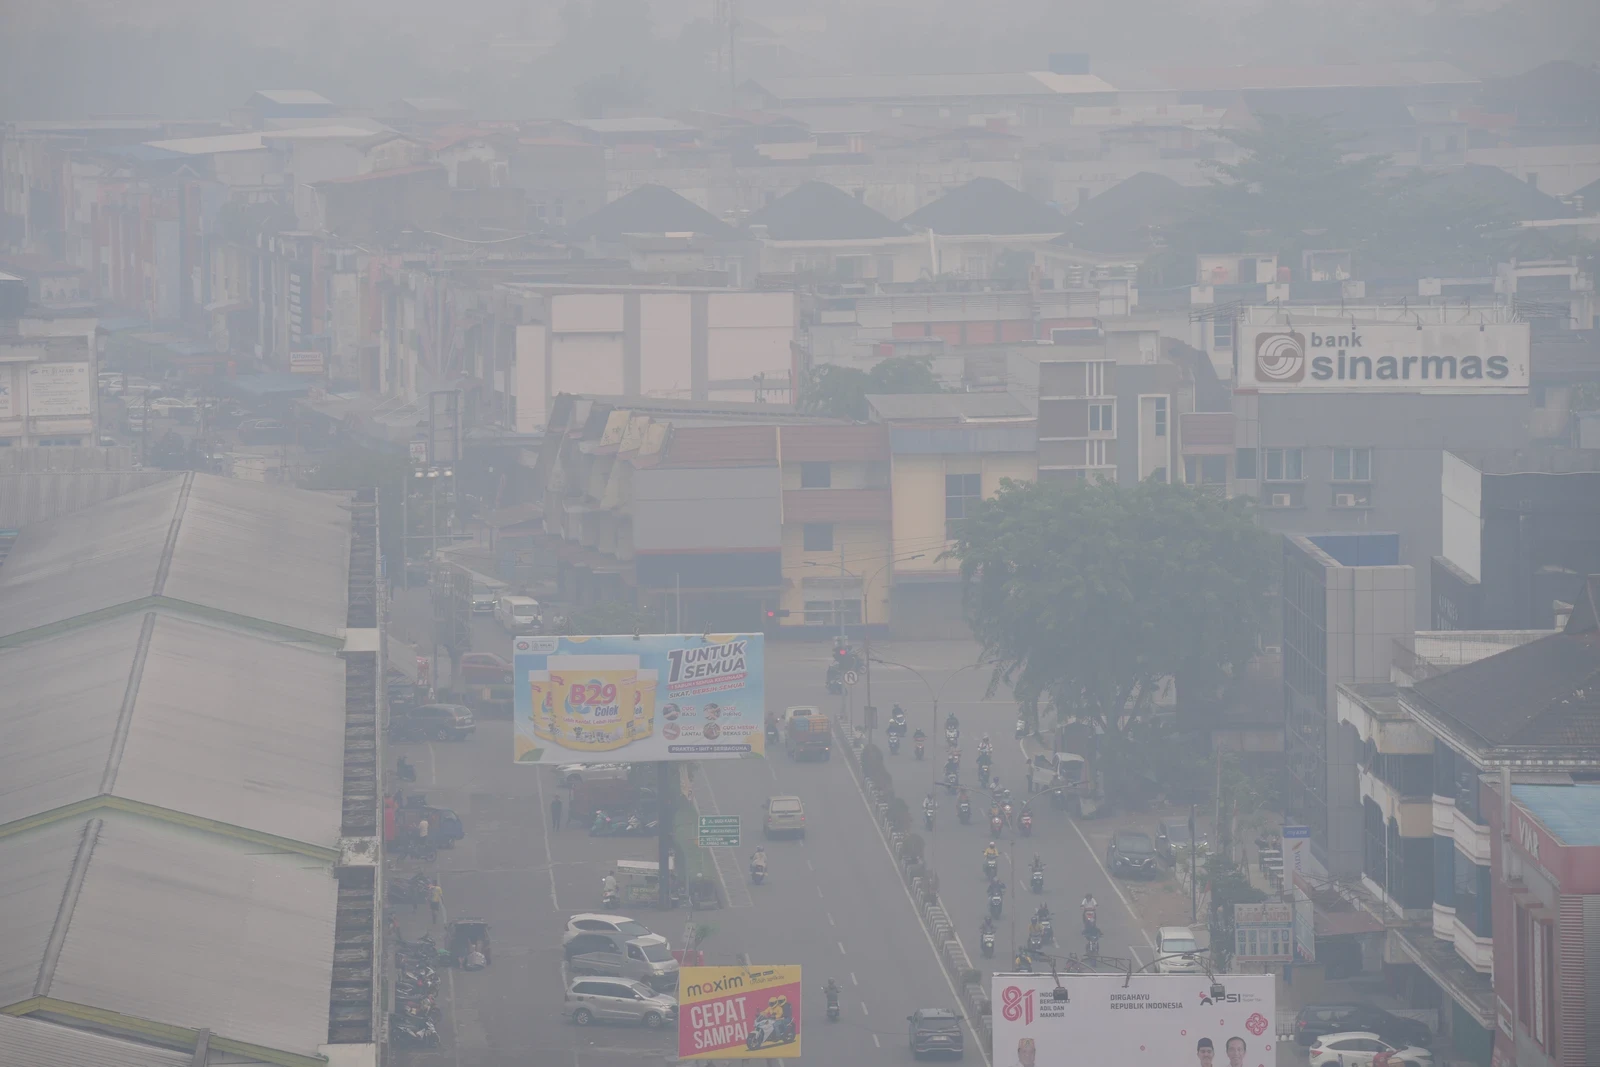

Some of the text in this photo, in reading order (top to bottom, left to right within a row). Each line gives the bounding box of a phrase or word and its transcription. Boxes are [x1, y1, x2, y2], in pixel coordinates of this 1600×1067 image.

[1311, 332, 1362, 348] bank
[1311, 350, 1509, 380] sinarmas
[684, 641, 746, 663] UNTUK
[668, 649, 683, 682] 1
[683, 657, 745, 679] SEMUA
[570, 683, 617, 706] B29
[669, 690, 691, 699] SIKAT,
[692, 686, 717, 695] BERSIH
[594, 704, 620, 717] Colek
[687, 975, 743, 997] maxim
[1110, 993, 1150, 1001] DIRGAHAYU
[1002, 985, 1035, 1026] 81
[1110, 1002, 1144, 1010] REPUBLIK
[1215, 993, 1241, 1003] PSI
[690, 997, 747, 1030] CEPAT
[693, 1022, 749, 1049] SAMPAI
